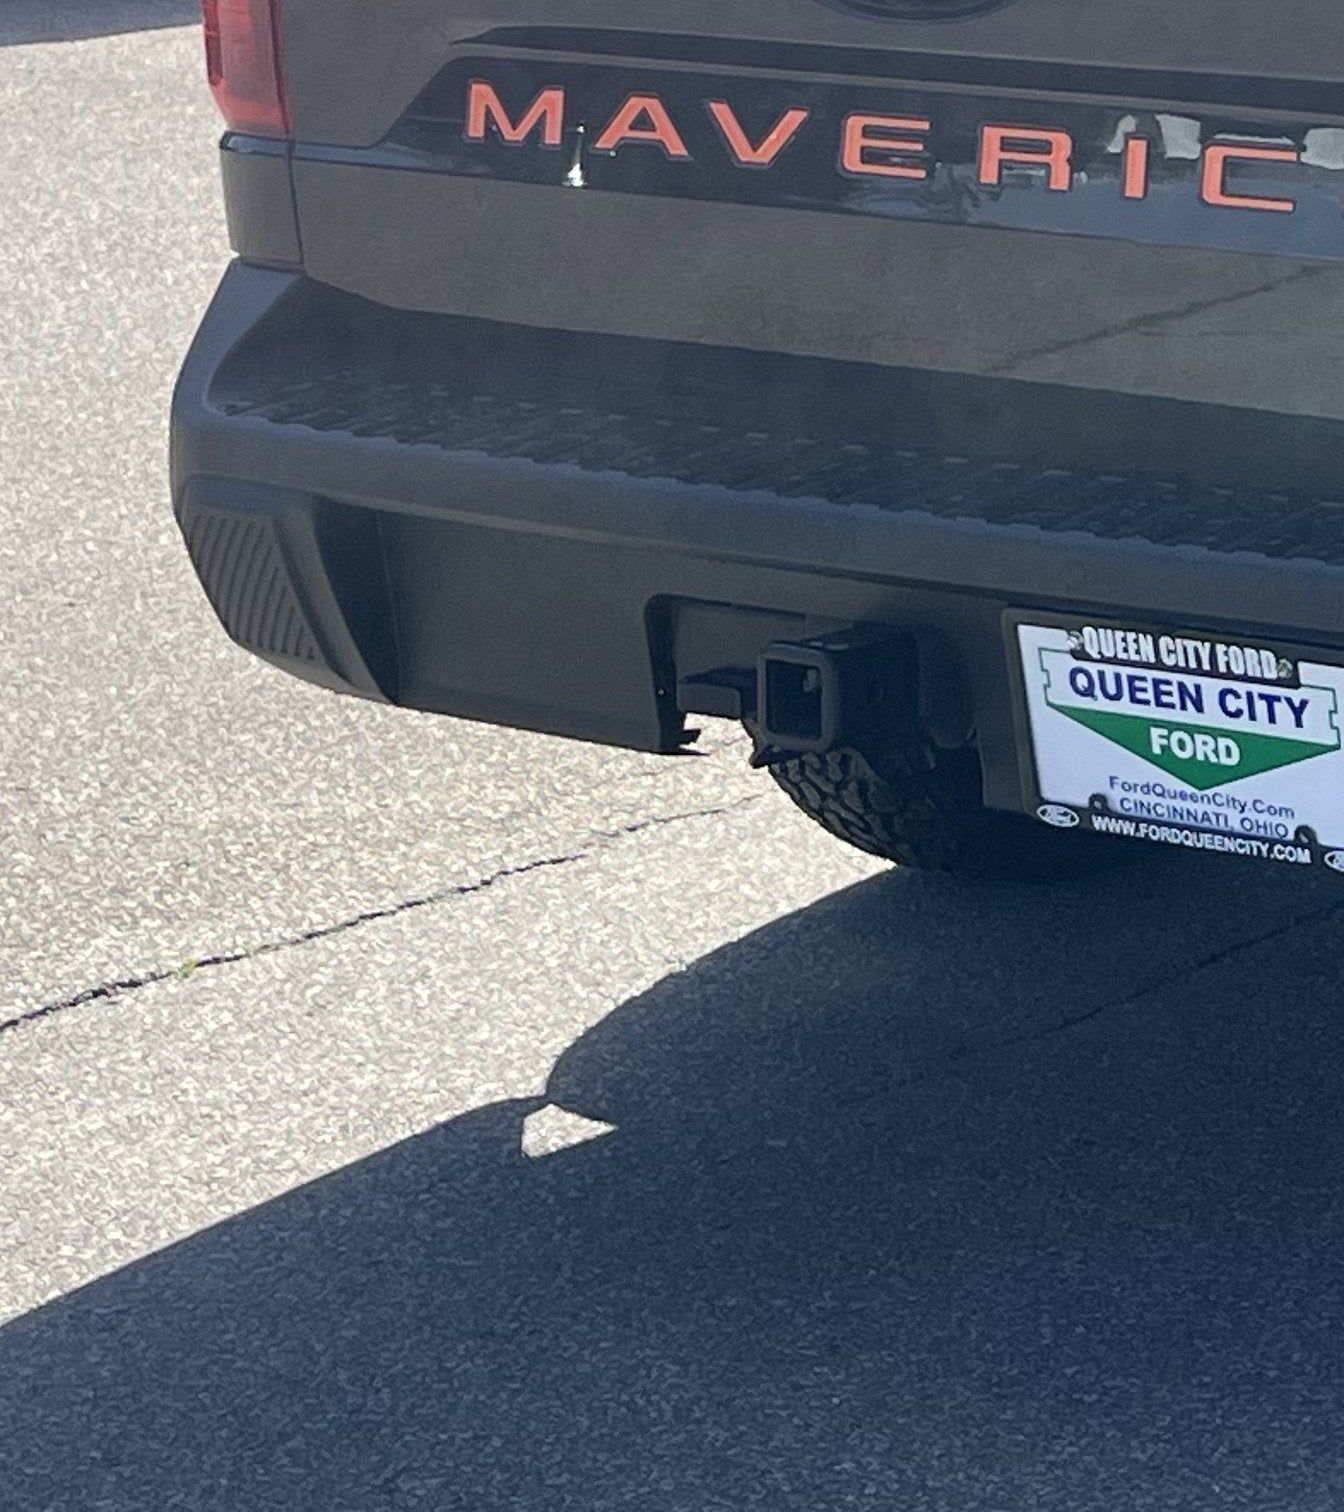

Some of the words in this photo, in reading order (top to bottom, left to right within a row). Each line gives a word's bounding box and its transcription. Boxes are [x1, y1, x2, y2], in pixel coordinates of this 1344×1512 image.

[1081, 626, 1156, 665] QUEEN
[1159, 635, 1211, 671] CITY
[1215, 643, 1279, 680] FORD
[1068, 666, 1205, 714] QUEEN
[1218, 687, 1310, 729] CITY
[1150, 726, 1241, 767] FORD
[1108, 775, 1296, 820] FordQueenCity.Com
[1119, 796, 1236, 831] CINCINNATI,
[1239, 816, 1290, 839] OHIO
[1091, 813, 1313, 865] WWW.FORDQUEENCITY.COM
